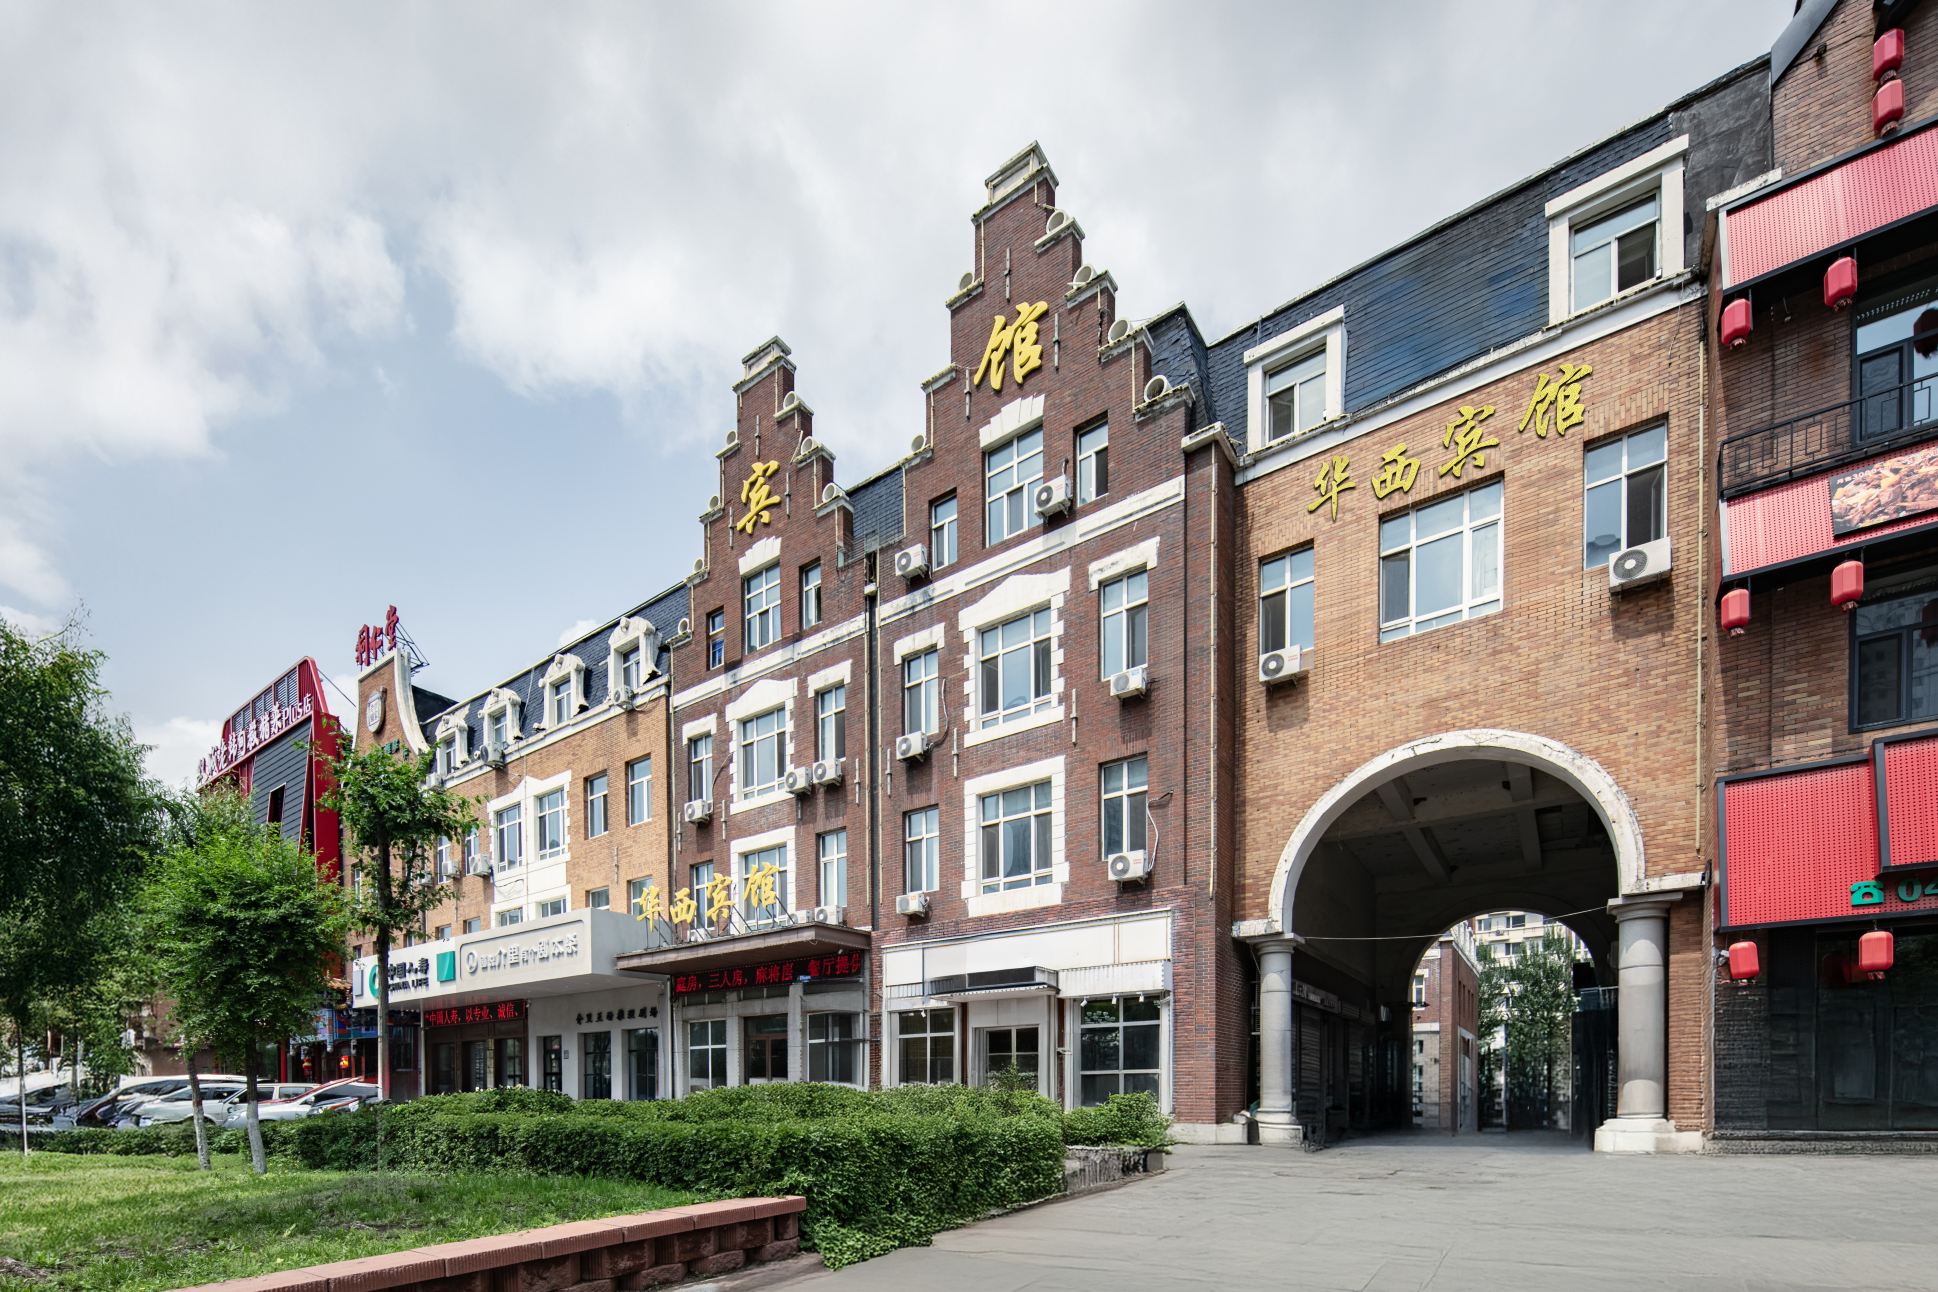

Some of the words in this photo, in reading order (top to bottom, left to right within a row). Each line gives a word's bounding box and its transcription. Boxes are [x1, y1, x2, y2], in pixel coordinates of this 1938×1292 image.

[973, 300, 1048, 391] 馆
[1307, 363, 1593, 521] 华西宾馆
[736, 460, 782, 534] 宾
[637, 861, 780, 931] 华西宾馆
[388, 958, 429, 981] 中国人寿
[412, 977, 429, 989] LIFE
